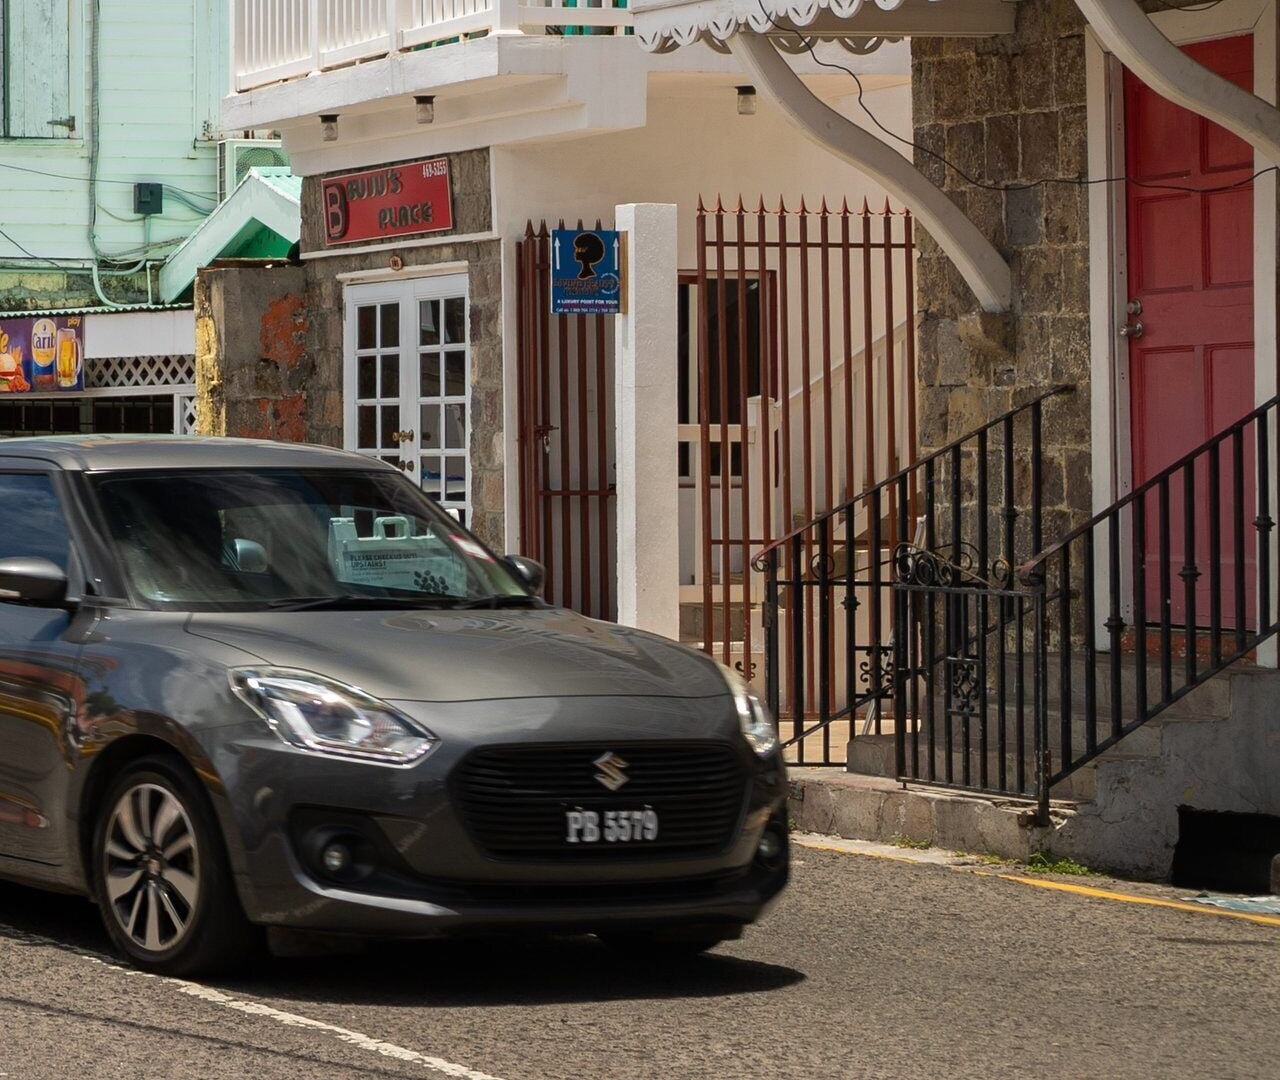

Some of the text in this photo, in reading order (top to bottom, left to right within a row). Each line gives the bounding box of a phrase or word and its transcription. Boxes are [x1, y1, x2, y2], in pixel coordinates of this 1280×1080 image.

[378, 201, 433, 229] PLACE
[565, 810, 659, 843] PB 5579
